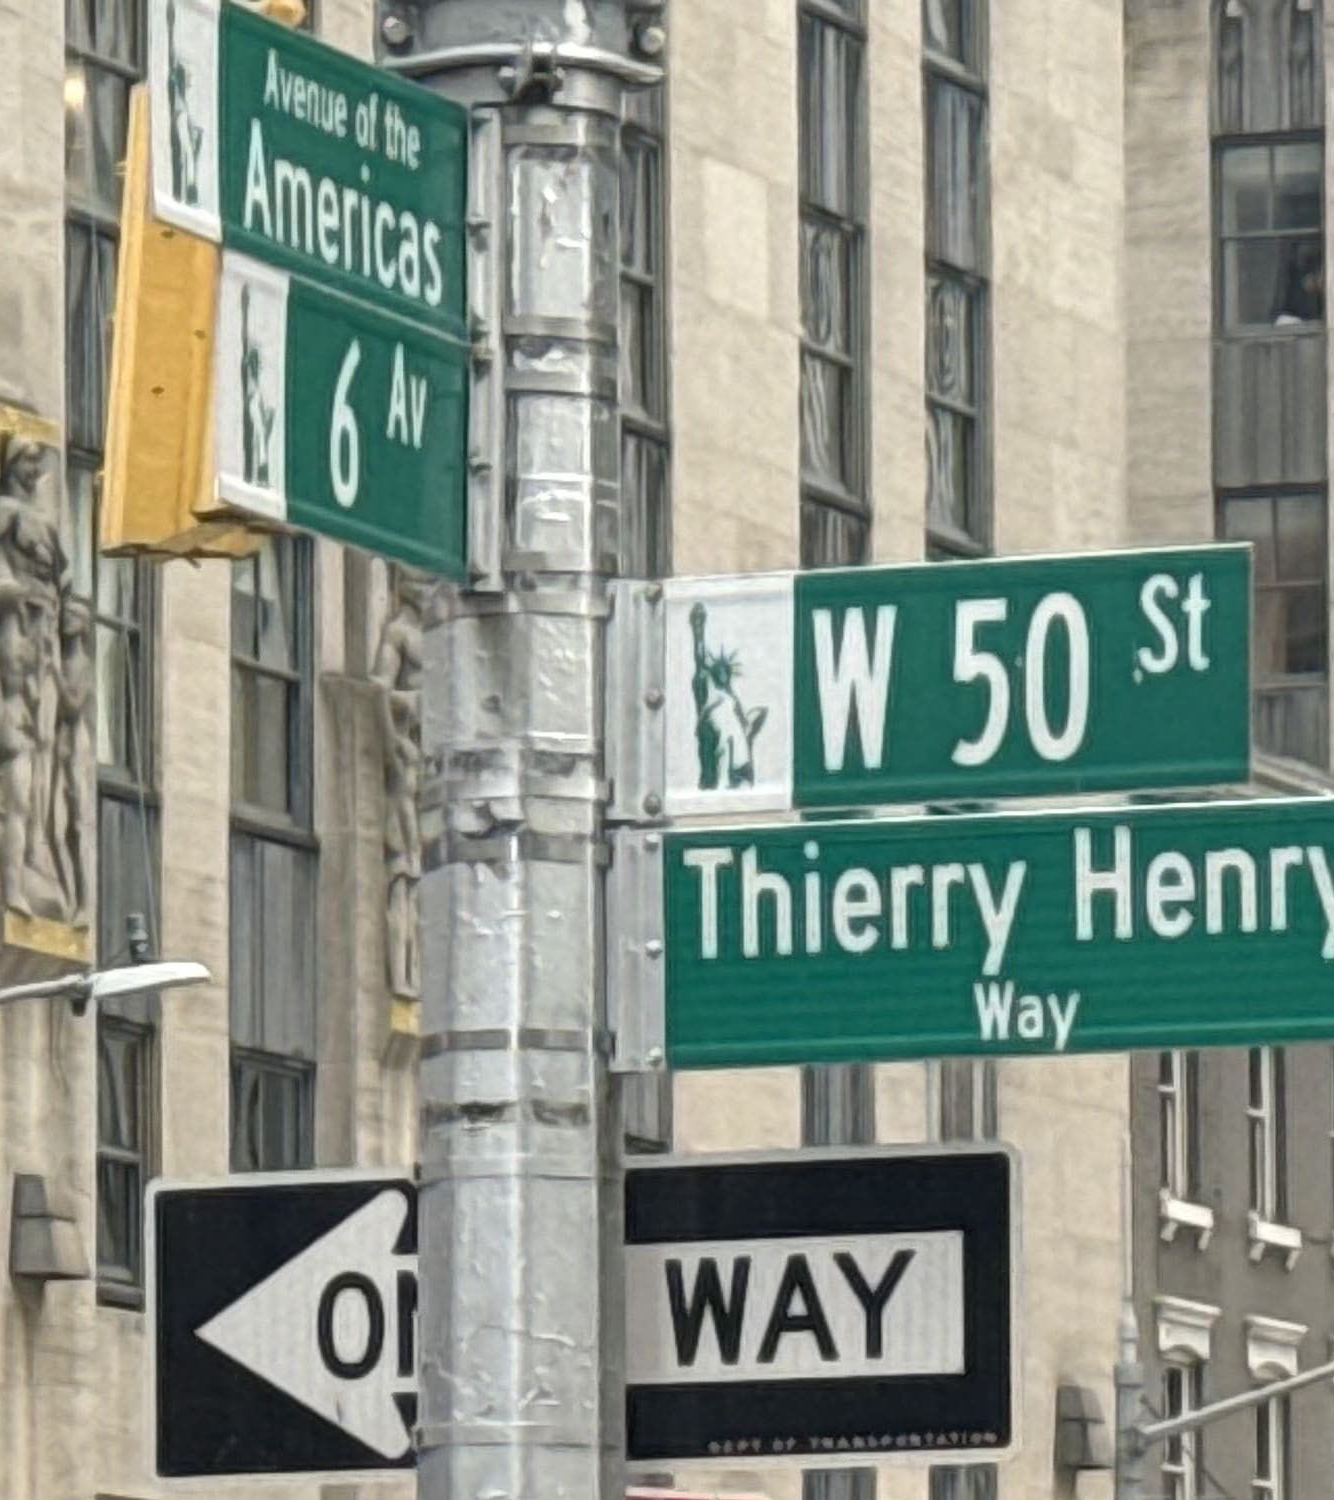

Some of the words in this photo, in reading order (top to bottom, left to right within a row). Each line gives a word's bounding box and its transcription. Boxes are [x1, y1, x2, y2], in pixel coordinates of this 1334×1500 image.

[265, 48, 347, 137] Avenue
[355, 93, 377, 147] of
[386, 104, 421, 170] the
[243, 117, 442, 306] Americas
[329, 337, 361, 508] 6
[387, 343, 427, 450] Av
[811, 604, 897, 772] W
[950, 592, 1091, 767] 50
[1138, 572, 1211, 675] St
[683, 841, 1027, 976] Thierry
[973, 981, 1081, 1051] Way
[666, 1248, 917, 1367] WAY
